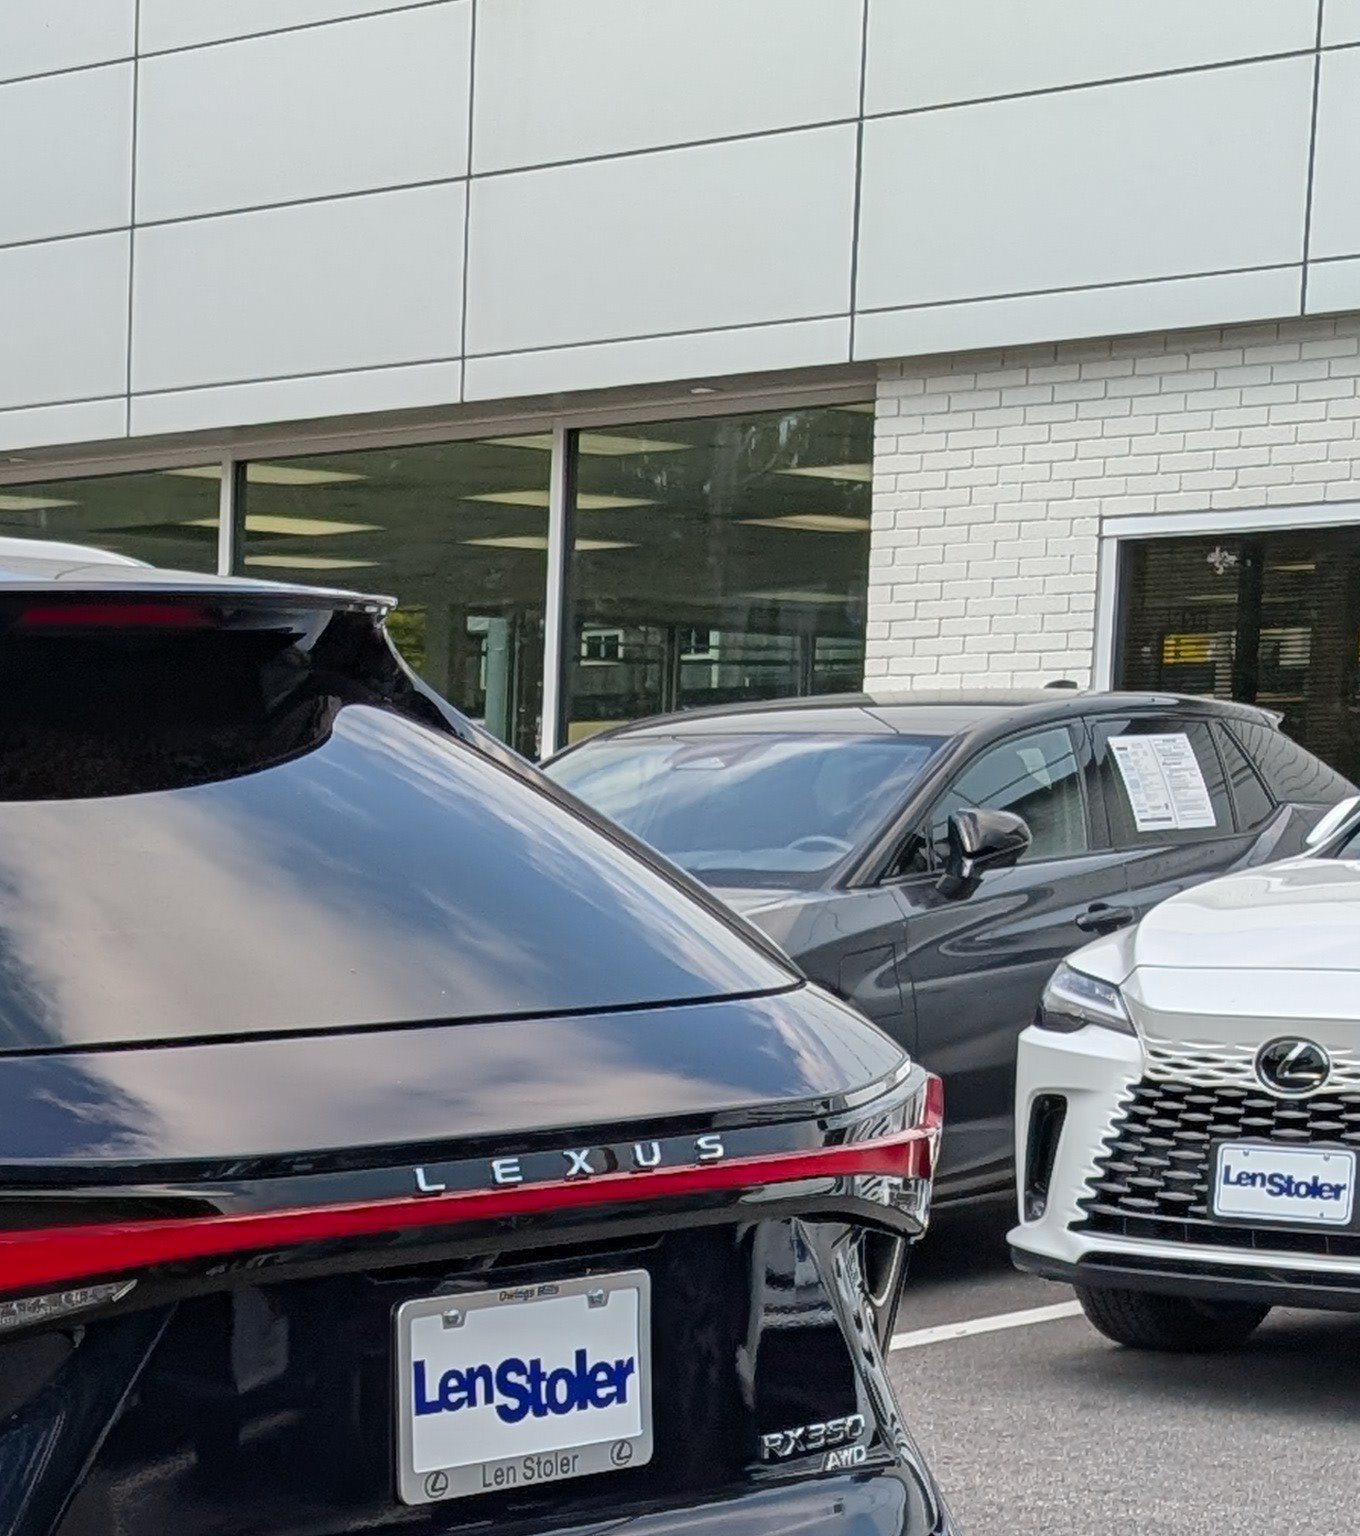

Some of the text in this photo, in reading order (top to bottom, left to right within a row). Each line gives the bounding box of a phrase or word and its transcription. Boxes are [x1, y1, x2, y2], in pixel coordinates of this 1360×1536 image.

[414, 1135, 725, 1193] LEXUS
[482, 1452, 579, 1488] Len Stoler
